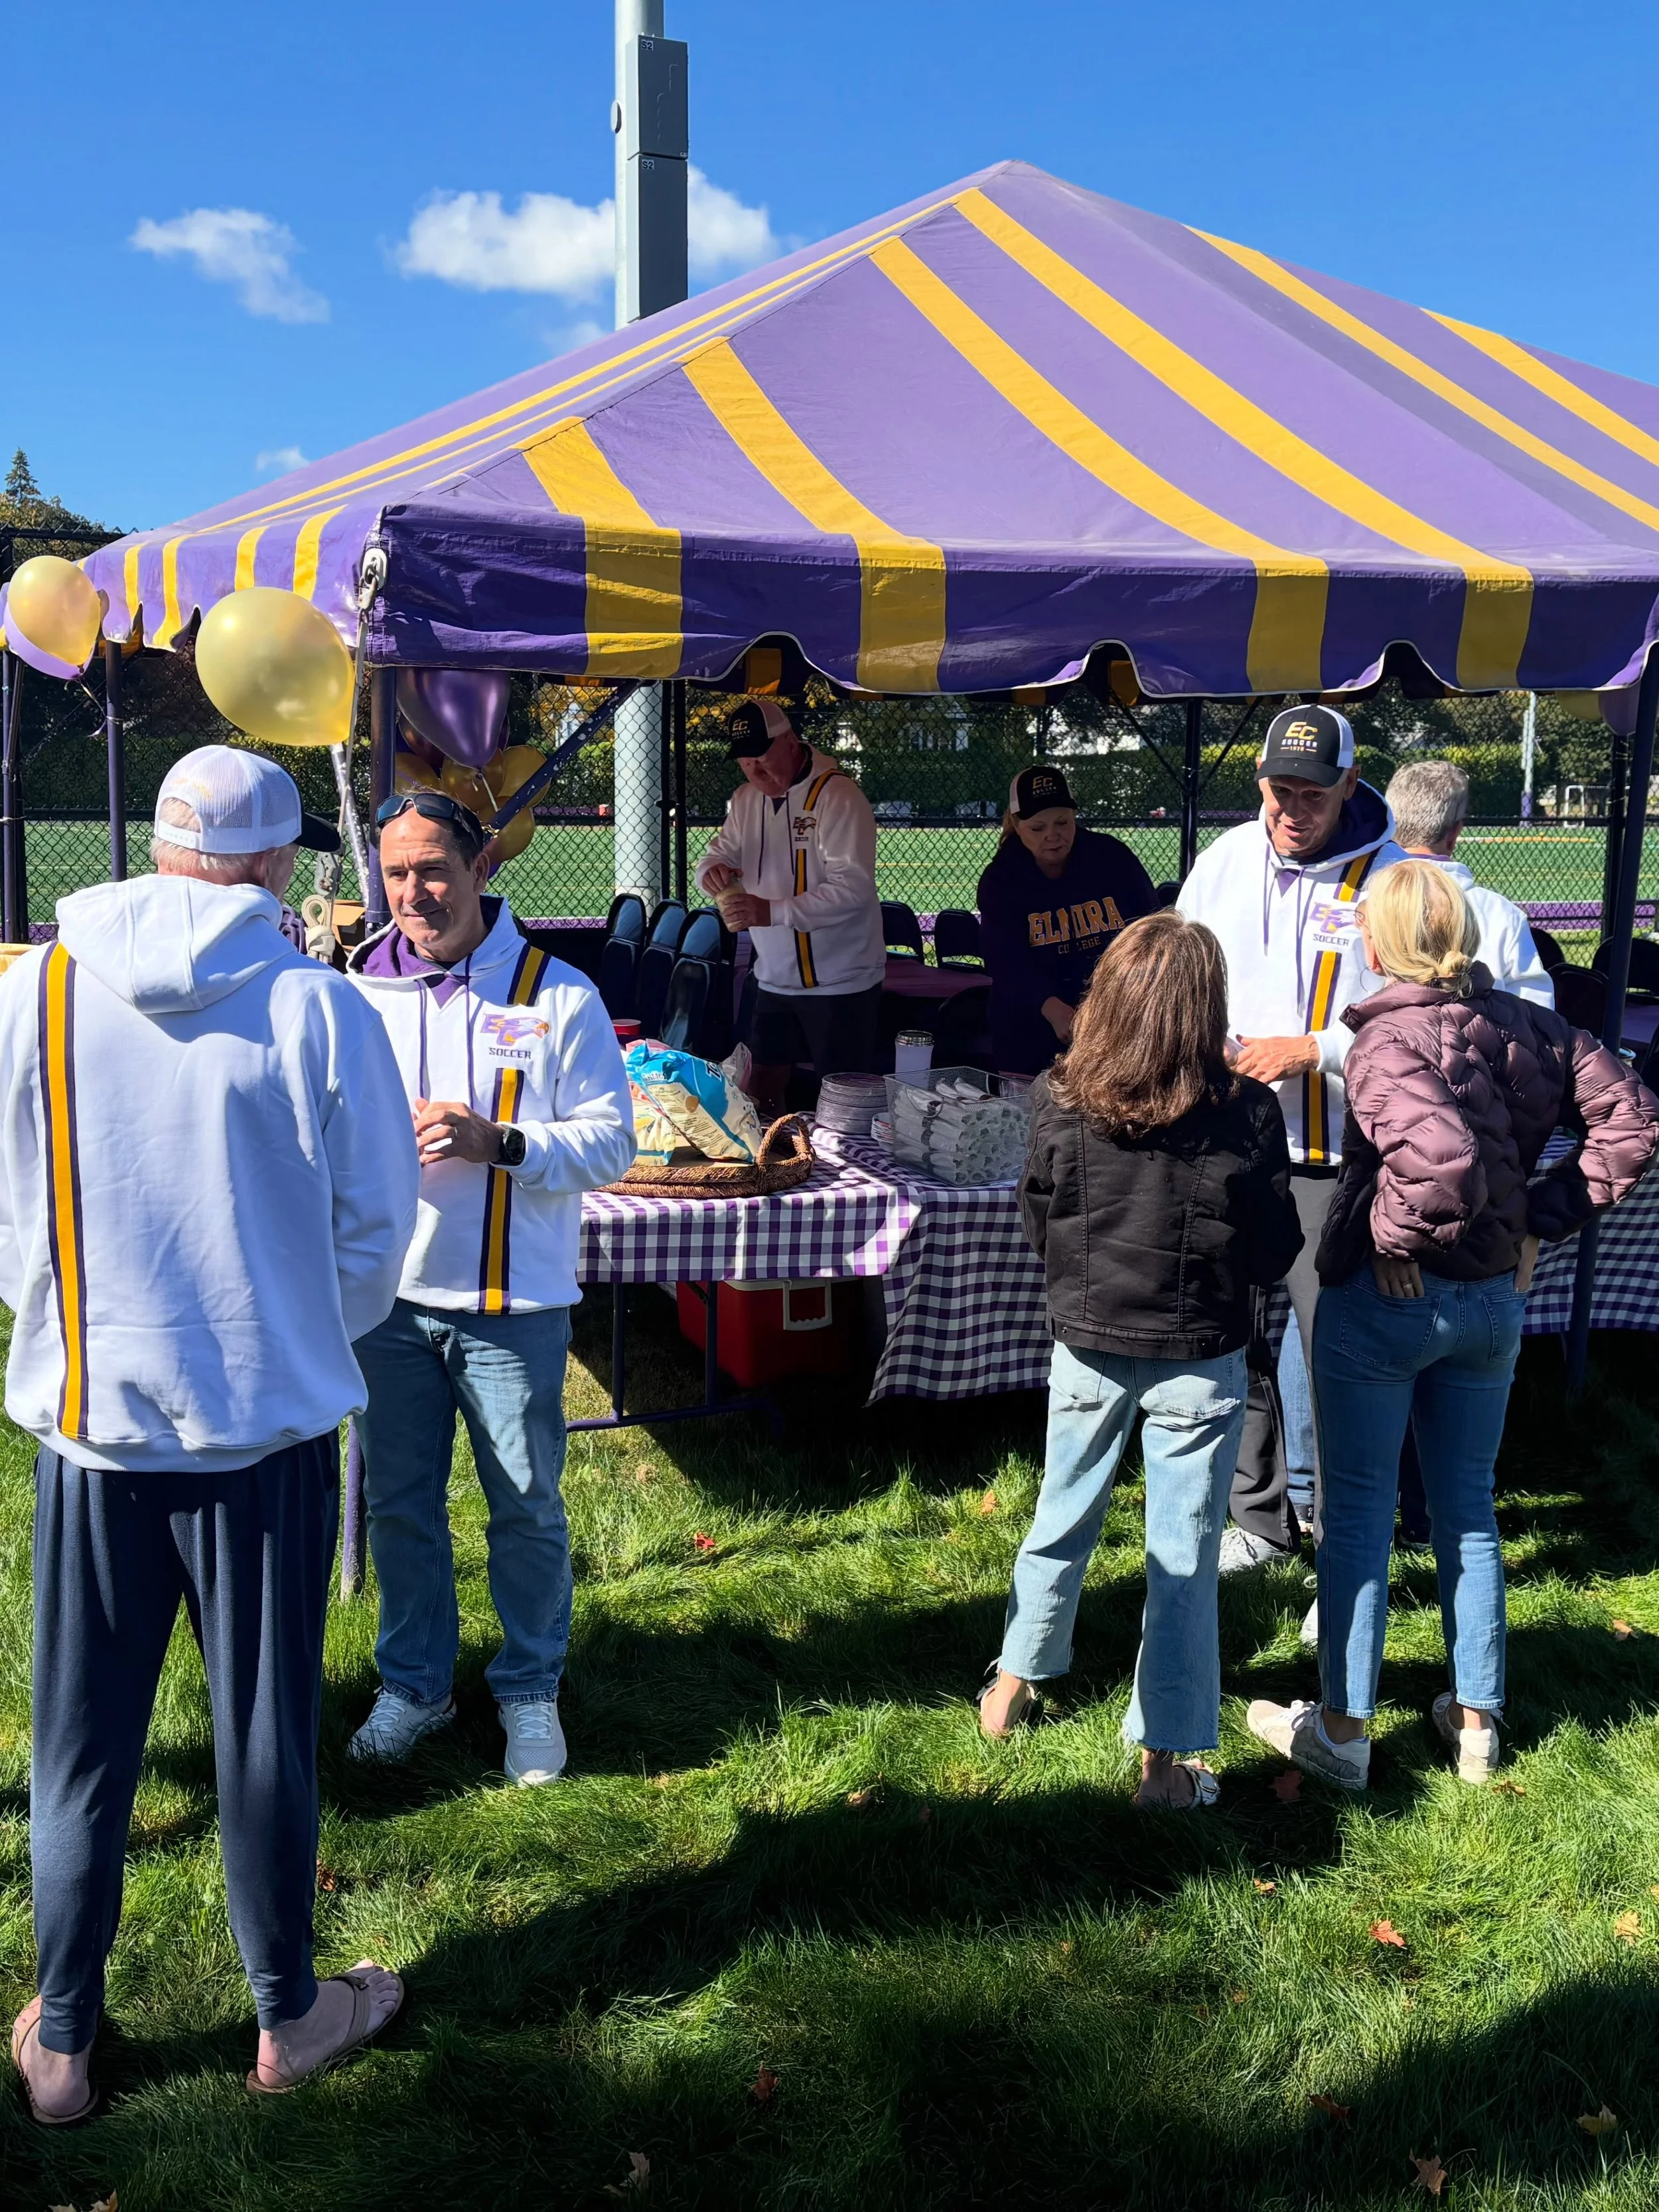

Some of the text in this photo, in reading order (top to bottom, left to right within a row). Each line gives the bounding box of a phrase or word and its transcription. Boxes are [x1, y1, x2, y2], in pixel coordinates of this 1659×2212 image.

[642, 40, 652, 50] S2
[642, 161, 653, 169] S2
[733, 719, 749, 731] EC
[1285, 721, 1318, 740] EC
[1033, 775, 1052, 789] EC
[1028, 897, 1125, 948] ELMIRA
[1313, 933, 1349, 946] SOCCER
[488, 1047, 532, 1060] SOCCER
